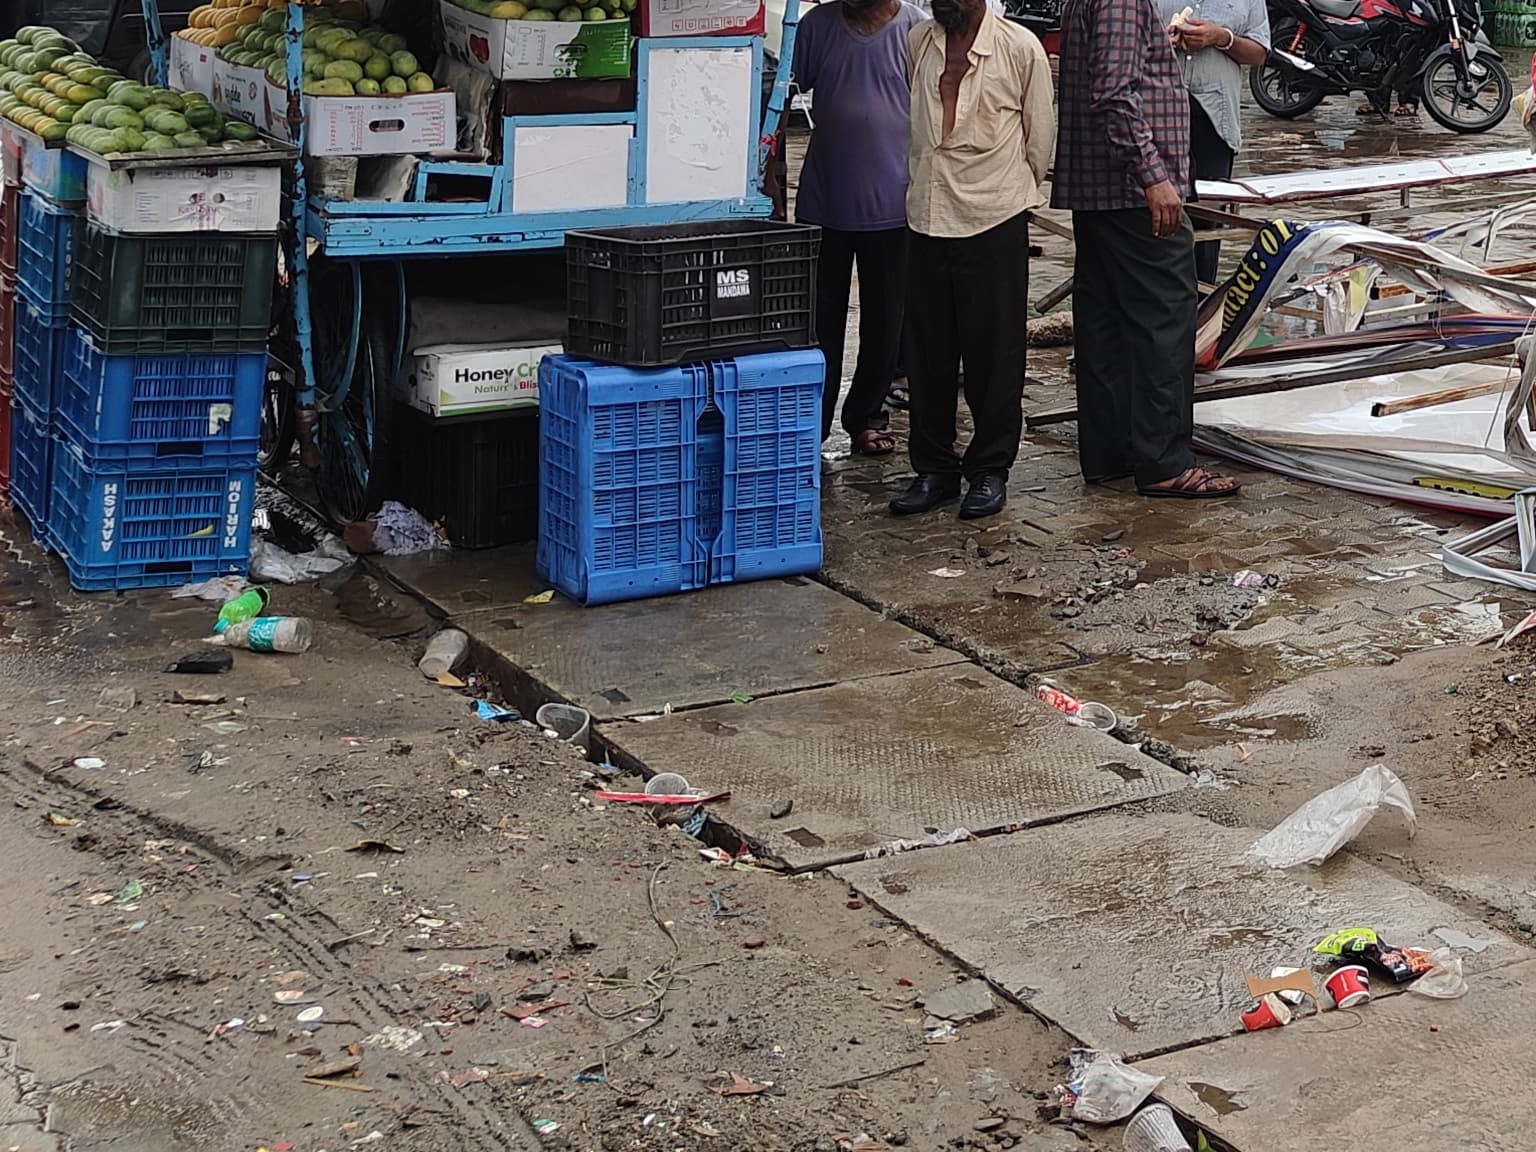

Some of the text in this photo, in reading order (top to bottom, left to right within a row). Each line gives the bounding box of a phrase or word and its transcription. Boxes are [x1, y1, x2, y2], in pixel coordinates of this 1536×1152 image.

[717, 269, 749, 284] MS
[455, 366, 515, 385] Honey
[101, 483, 117, 552] AAKASH
[224, 480, 241, 548] HARIOM
